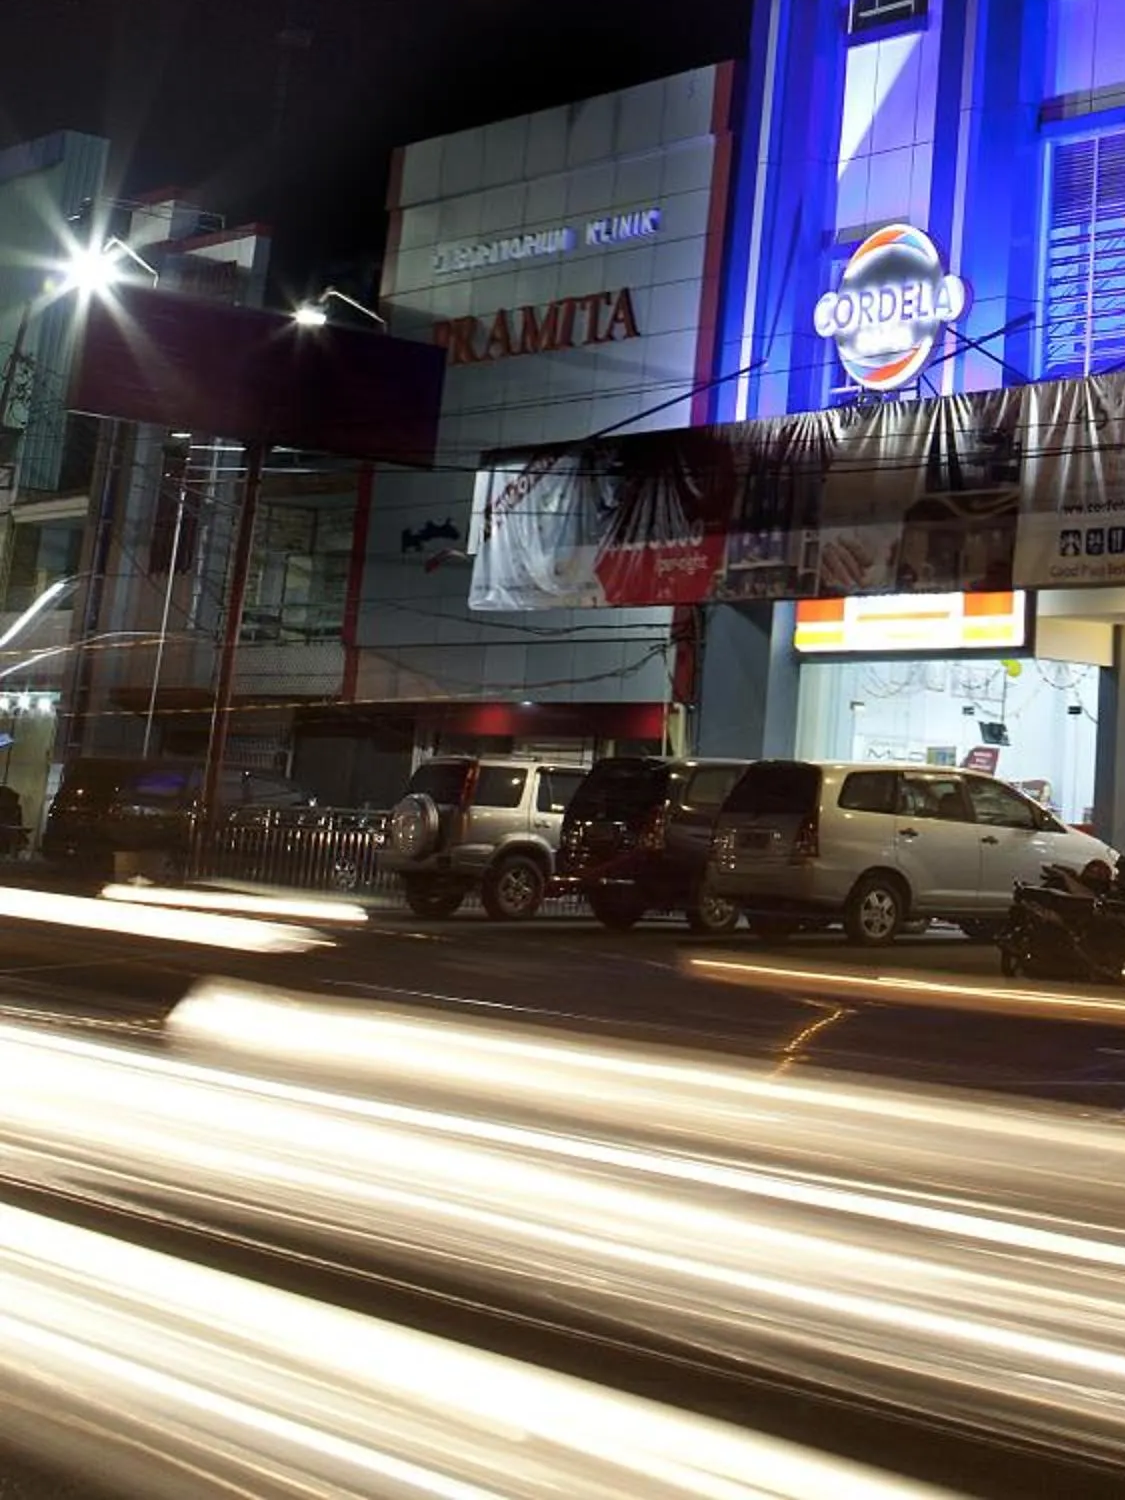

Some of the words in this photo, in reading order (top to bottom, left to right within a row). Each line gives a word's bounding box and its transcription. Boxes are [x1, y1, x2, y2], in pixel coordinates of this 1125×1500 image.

[586, 207, 662, 245] KLINIK
[433, 287, 641, 366] PRAMITA
[815, 277, 957, 332] CORDELA
